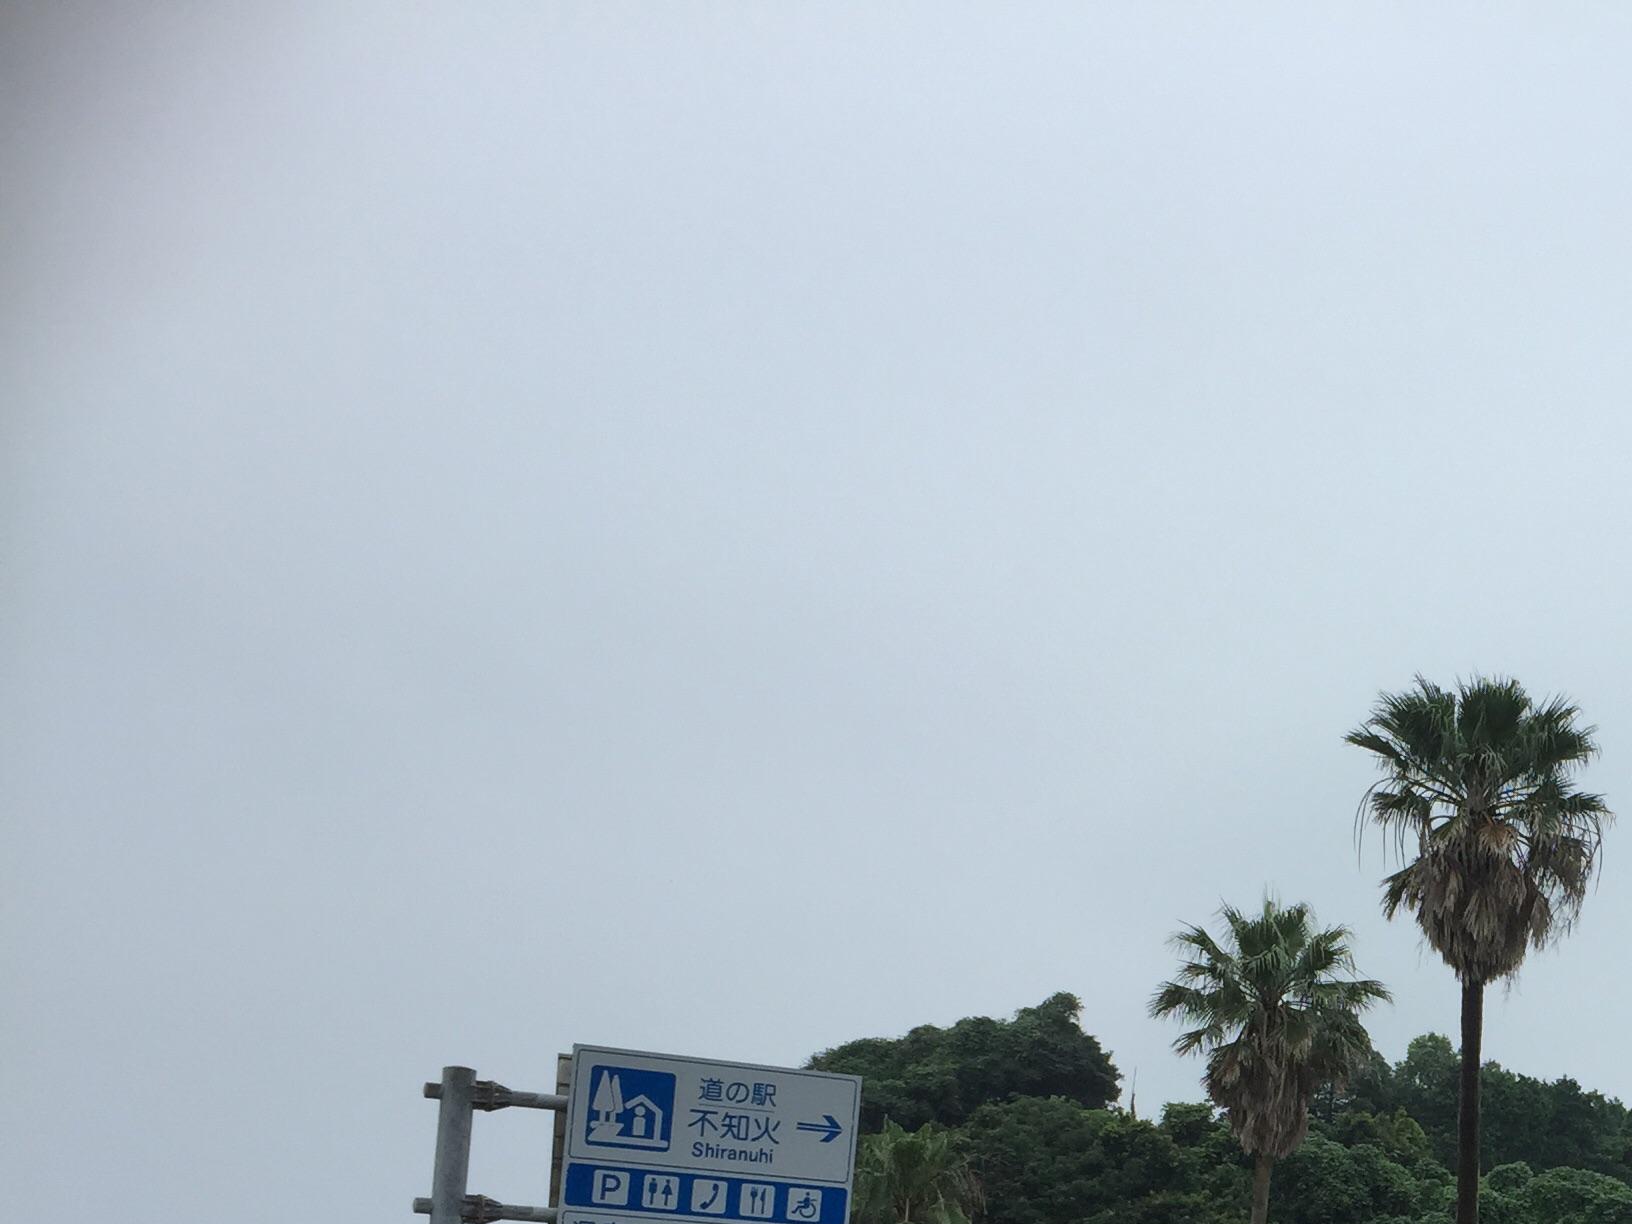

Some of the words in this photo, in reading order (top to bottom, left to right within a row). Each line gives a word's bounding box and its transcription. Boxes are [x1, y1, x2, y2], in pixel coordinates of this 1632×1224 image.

[698, 1077, 777, 1107] 道の駅
[687, 1107, 781, 1145] 不知火
[692, 1141, 774, 1165] Shiranuhi
